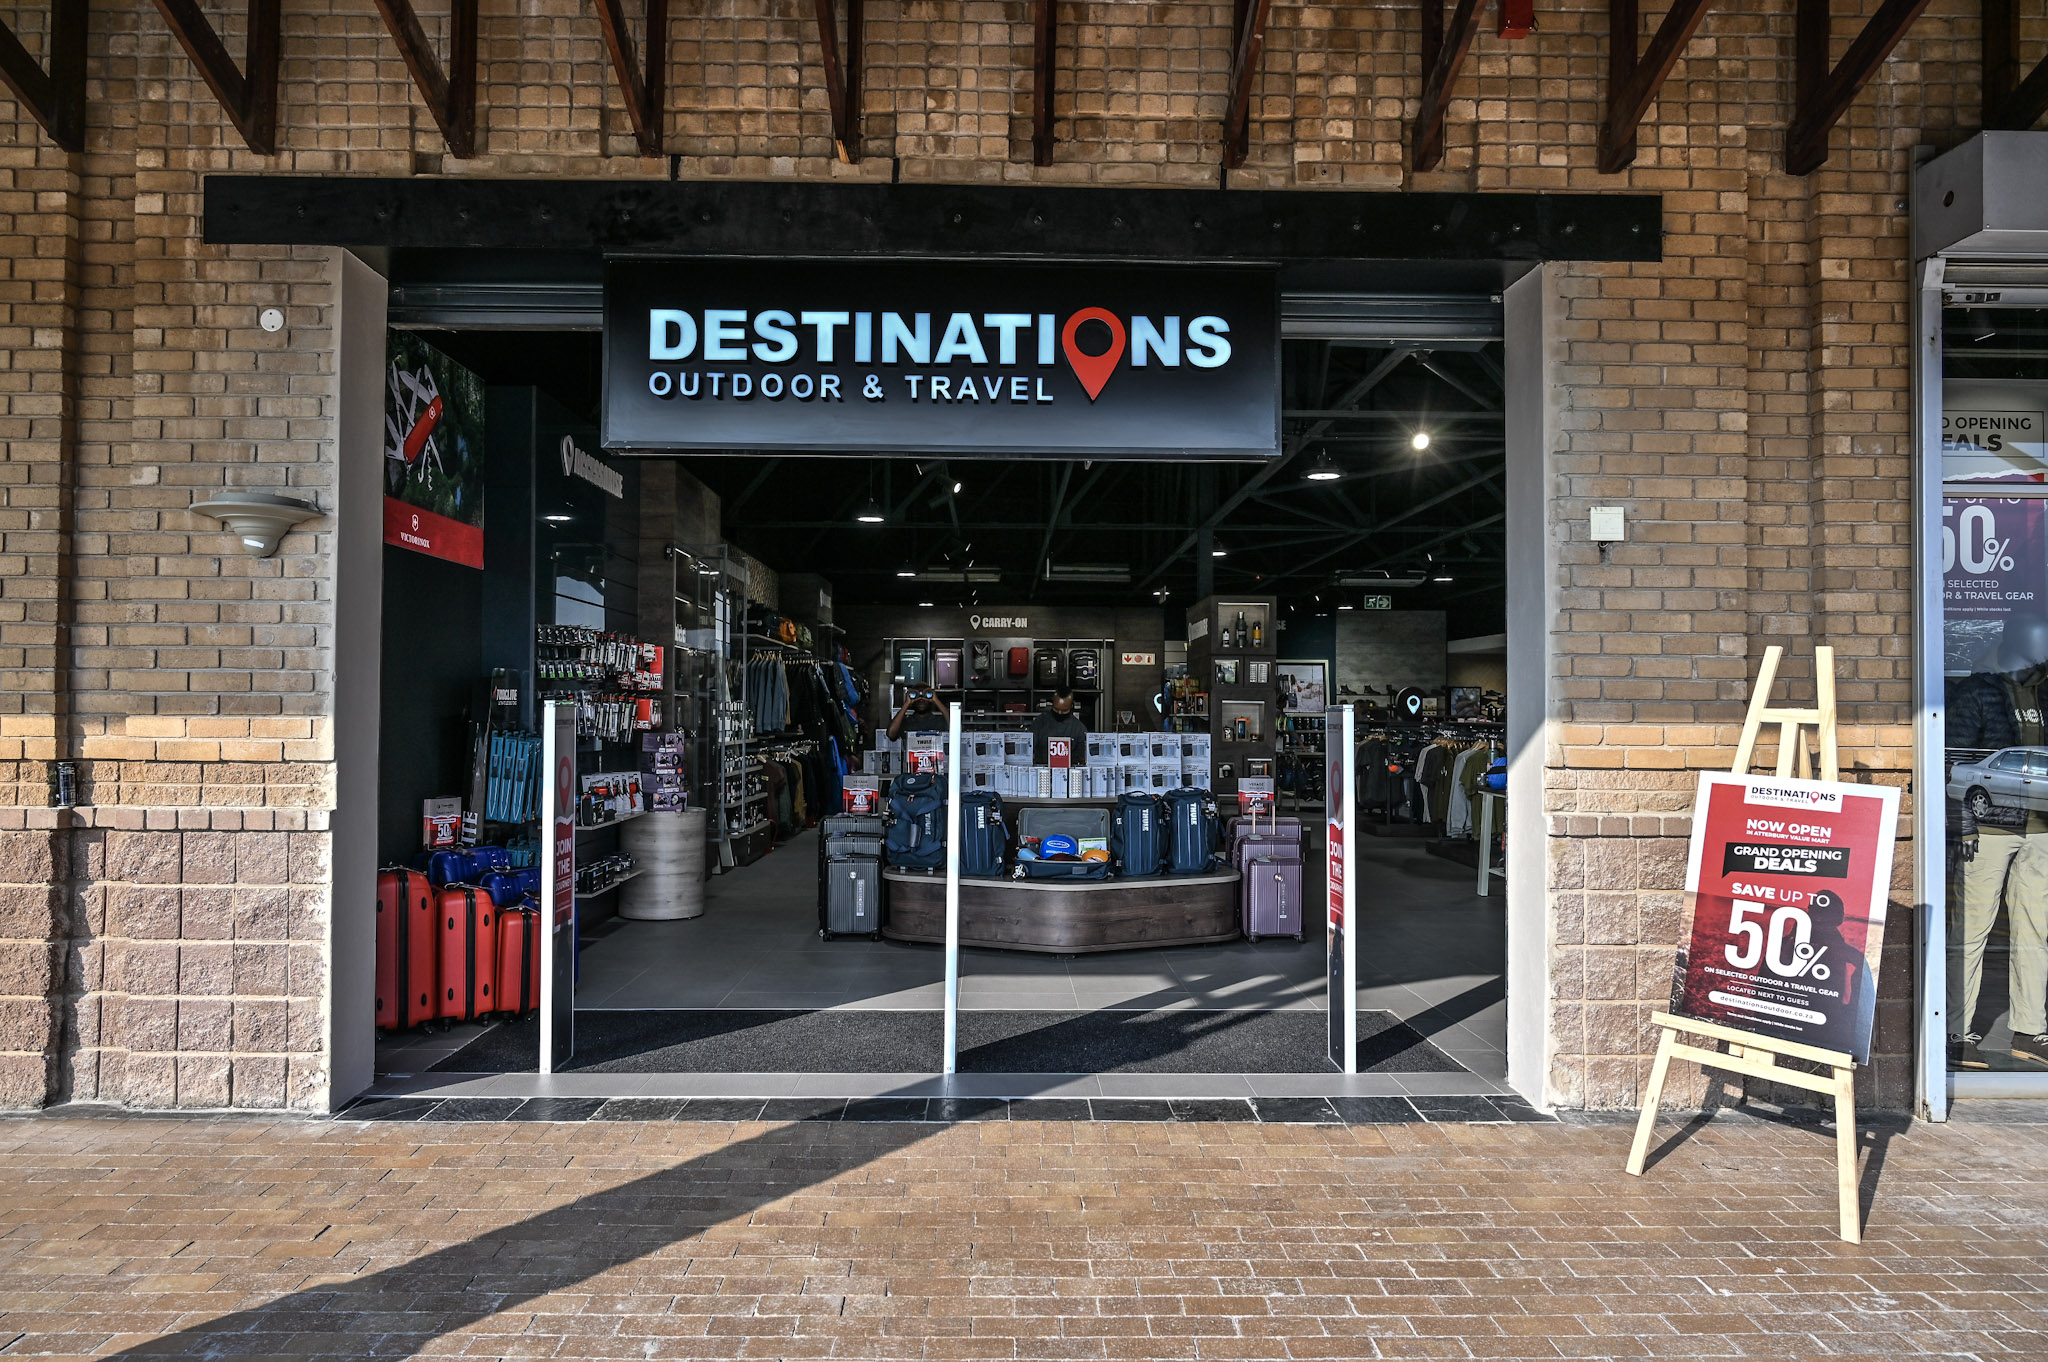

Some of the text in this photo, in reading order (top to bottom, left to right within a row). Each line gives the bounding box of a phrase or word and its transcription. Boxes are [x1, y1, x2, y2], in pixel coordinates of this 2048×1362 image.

[648, 306, 1232, 372] DESTINATIONS
[647, 371, 1054, 402] OUTDOOR & TRAVEL
[1955, 416, 2032, 430] OPENING
[1942, 433, 2003, 452] EALS
[1947, 579, 1999, 589] SELECTED
[1954, 591, 1962, 600] &
[1963, 591, 2003, 600] TRAVEL
[2005, 591, 2034, 600] GEAR
[982, 617, 1028, 628] CARRY-ON
[1751, 786, 1836, 803] DESTINATIONS
[977, 805, 985, 829] THULE
[1142, 808, 1150, 832] THULE
[1189, 802, 1198, 826] THULE
[1746, 818, 1832, 839] NOW OPEN
[1754, 830, 1789, 840] ATTERBURY
[1789, 834, 1810, 843] VALUE
[556, 837, 572, 857] JOIN
[1733, 845, 1842, 861] GRAND OPENING
[557, 857, 571, 876] THE
[1753, 856, 1817, 873] DEALS
[1731, 882, 1831, 908] SAVE UP TO
[1724, 898, 1831, 981] 50%
[1704, 966, 1715, 974] ON
[1715, 968, 1748, 980] SELECTED
[1748, 974, 1784, 987] OUTDOOR
[1789, 982, 1818, 994] TRAVEL
[1818, 988, 1840, 998] GEAR
[1726, 984, 1810, 1007] LOCATED NEXT TO GUESS
[1720, 995, 1814, 1020] destinationsoutdoor.co.za
